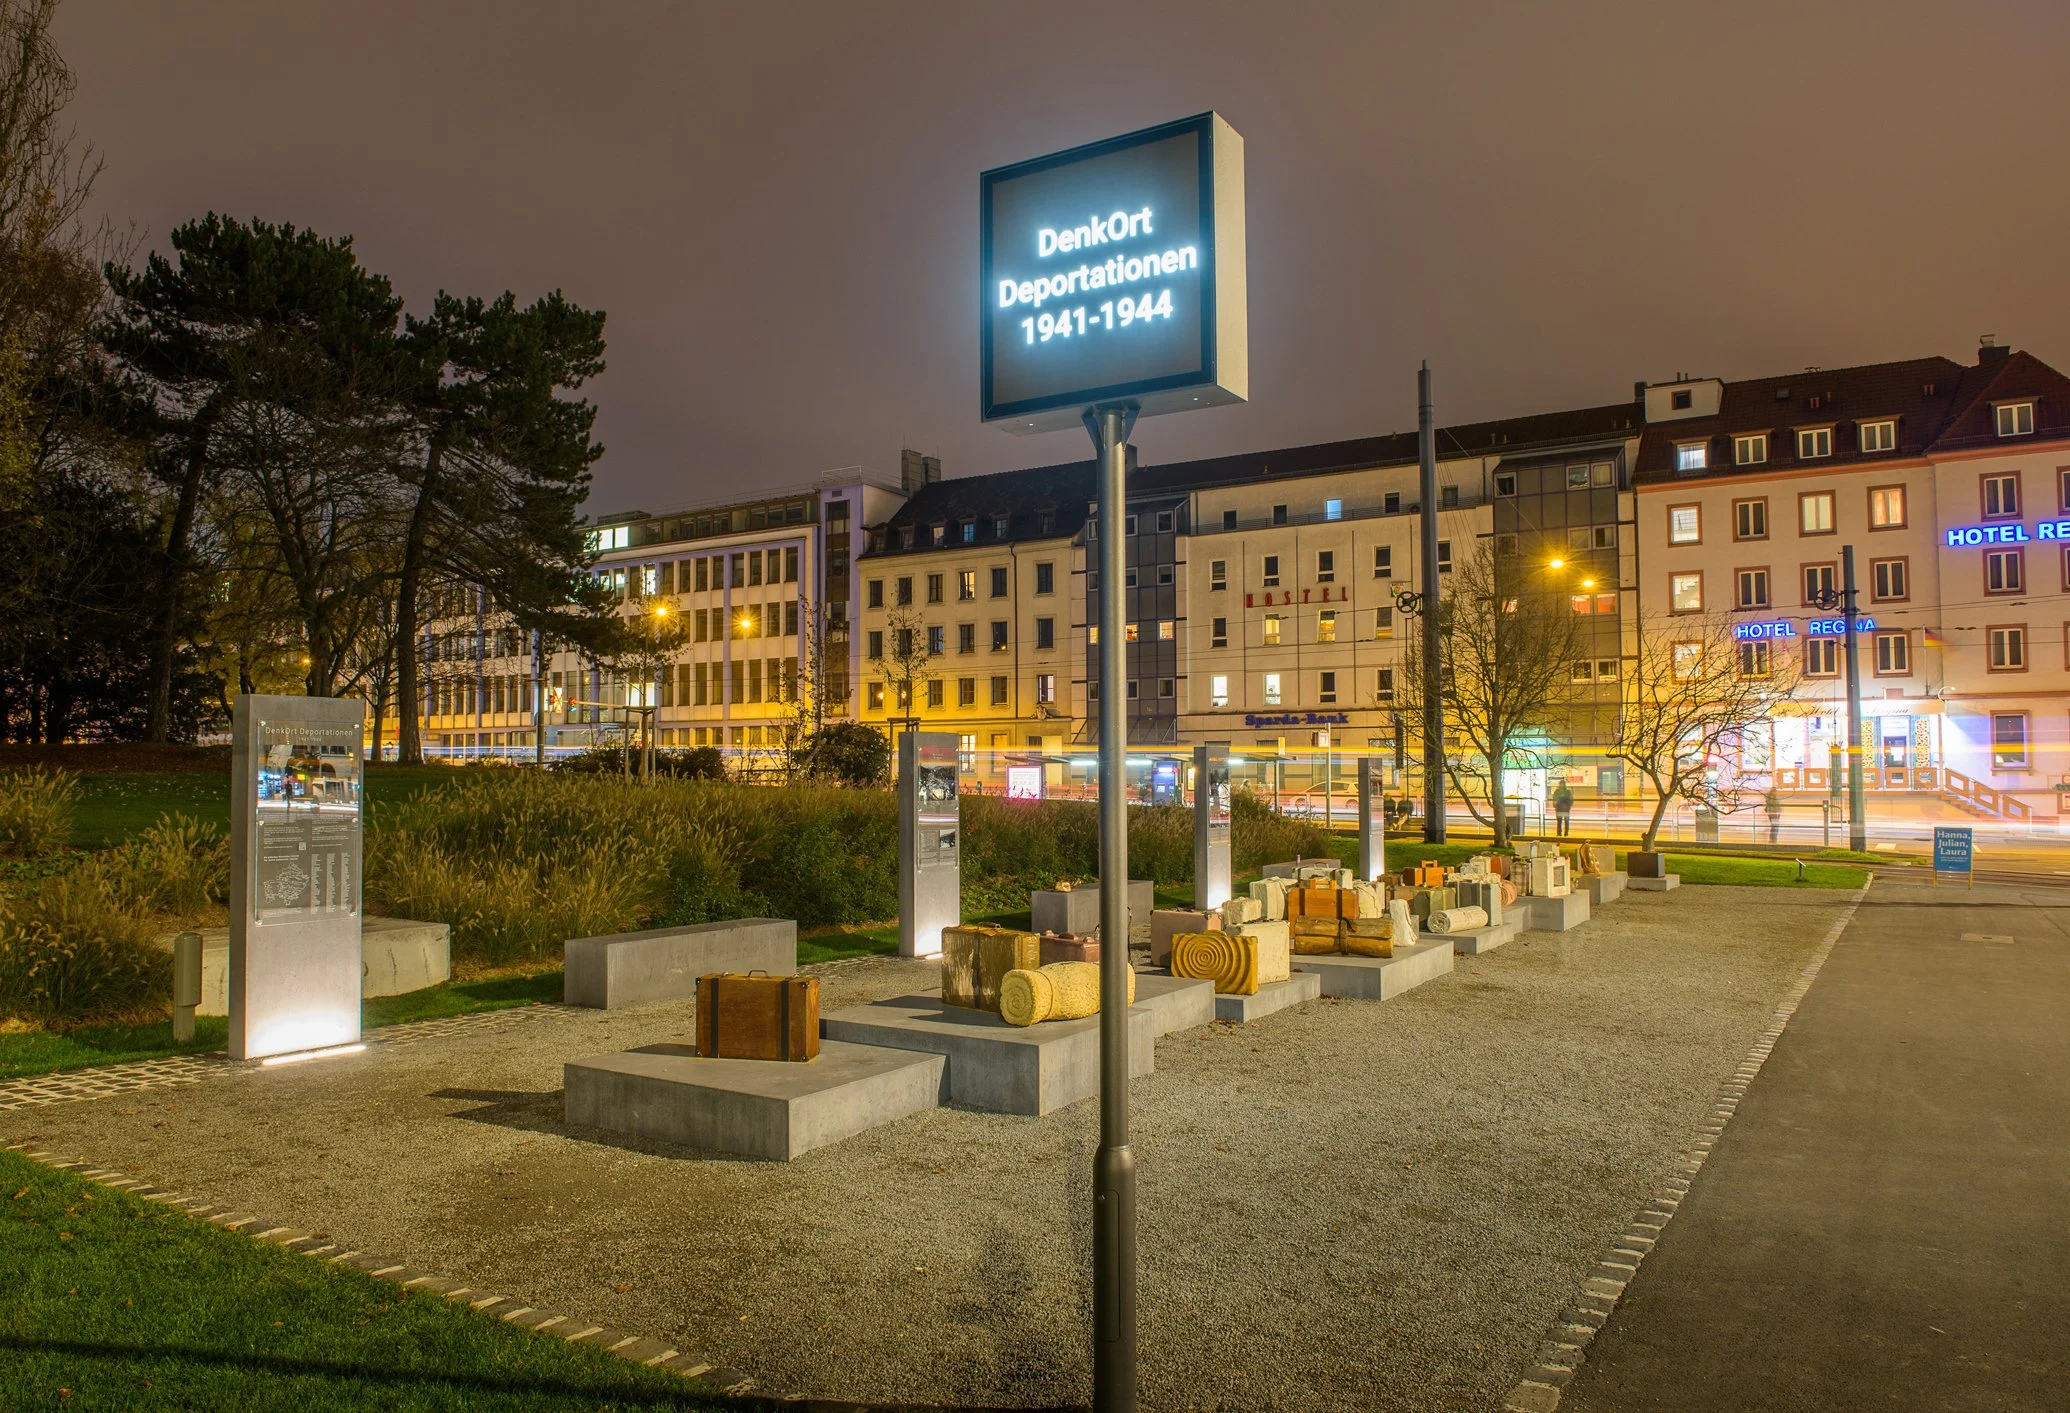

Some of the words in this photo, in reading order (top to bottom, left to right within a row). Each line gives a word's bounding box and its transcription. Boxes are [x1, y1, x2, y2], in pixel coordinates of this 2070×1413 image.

[1037, 206, 1153, 257] DenkOrt
[999, 245, 1197, 308] Deportationen
[1021, 289, 1173, 344] 1941-1944
[1947, 524, 2031, 546] HOTEL
[1246, 587, 1348, 608] HOSTEL
[1737, 622, 1796, 638] HOTEL
[1810, 618, 1875, 635] REGNA
[1245, 713, 1349, 728] Sparda-Bank
[265, 727, 297, 735] DenkOrt
[300, 727, 353, 736] Deportationen
[1937, 831, 1970, 839] Hanna,
[1938, 839, 1968, 848] Julian,
